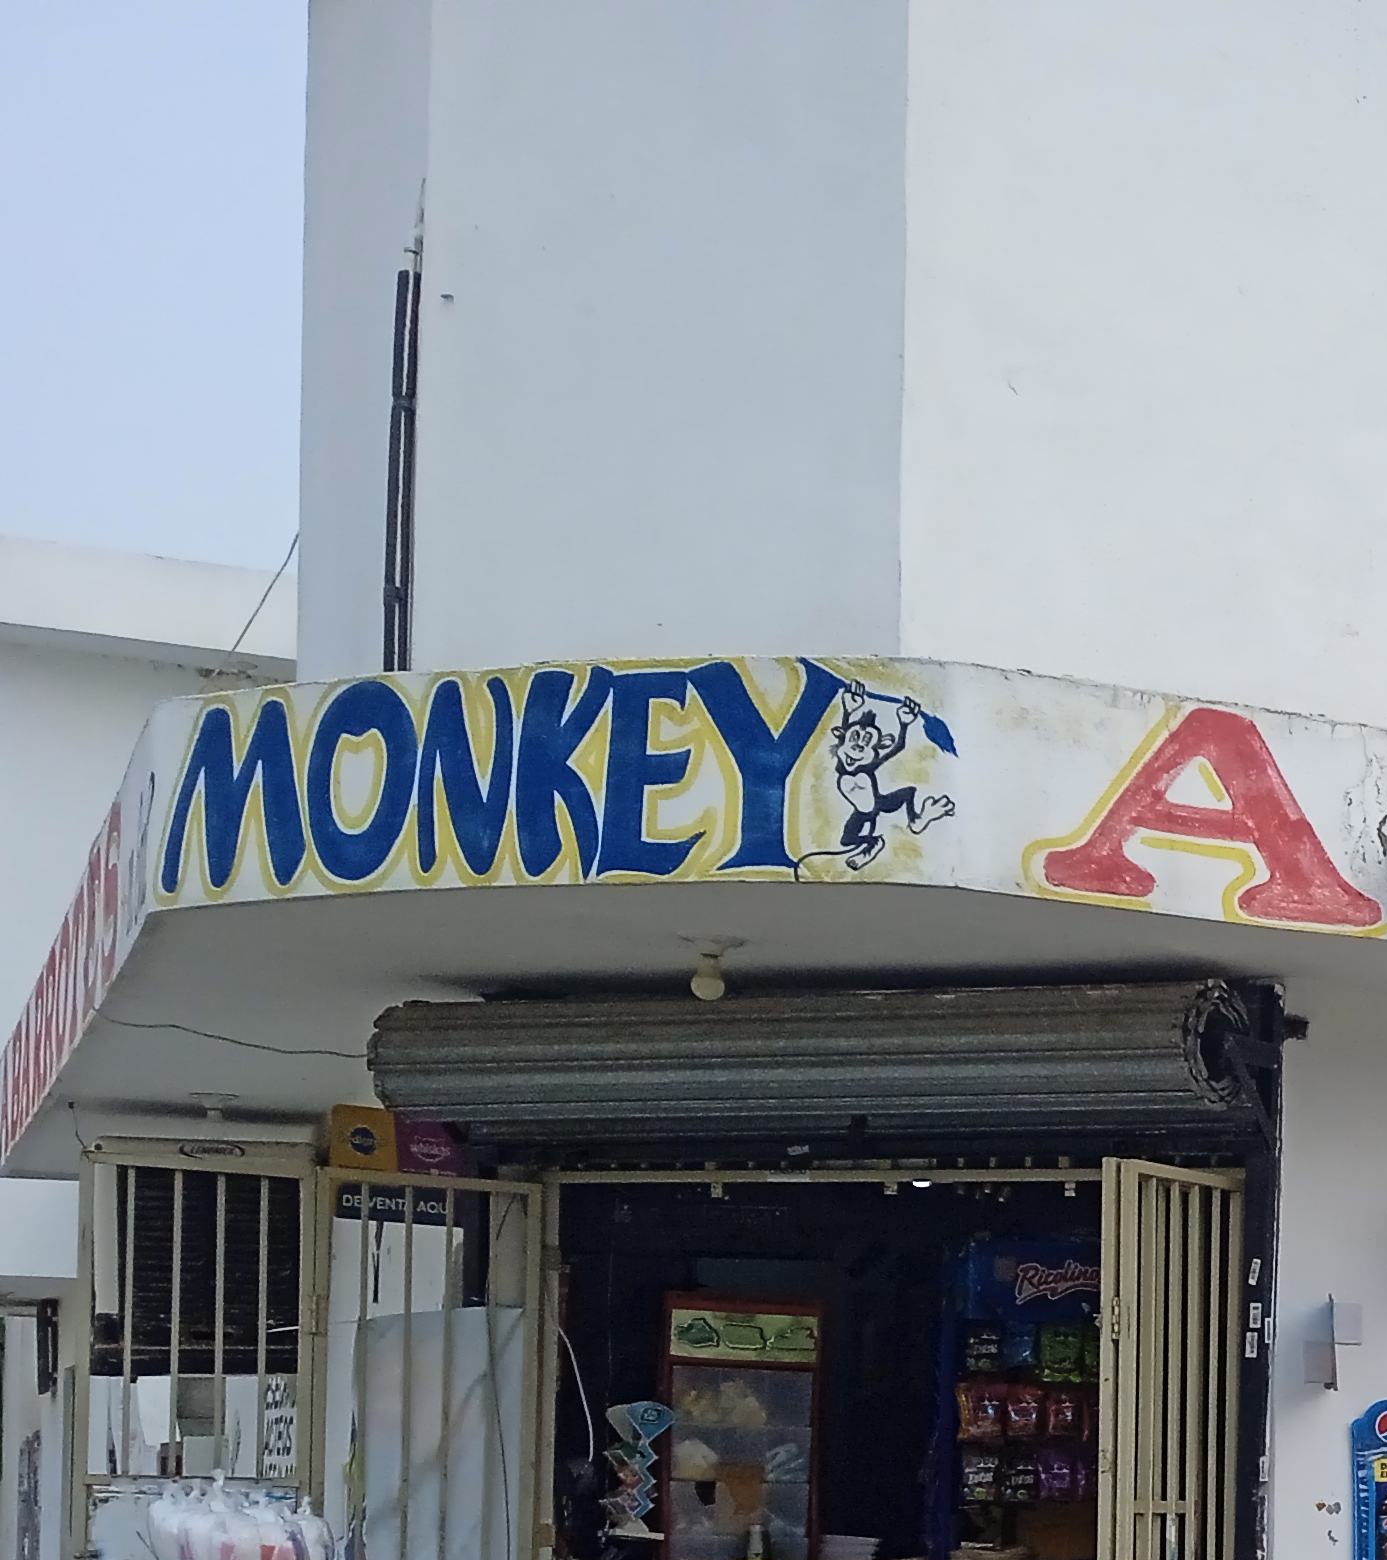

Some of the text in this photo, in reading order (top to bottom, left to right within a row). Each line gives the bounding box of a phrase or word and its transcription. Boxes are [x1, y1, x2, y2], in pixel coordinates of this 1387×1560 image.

[158, 656, 846, 895] MONKEY
[342, 1194, 362, 1209] DE
[416, 1201, 450, 1215] AQU
